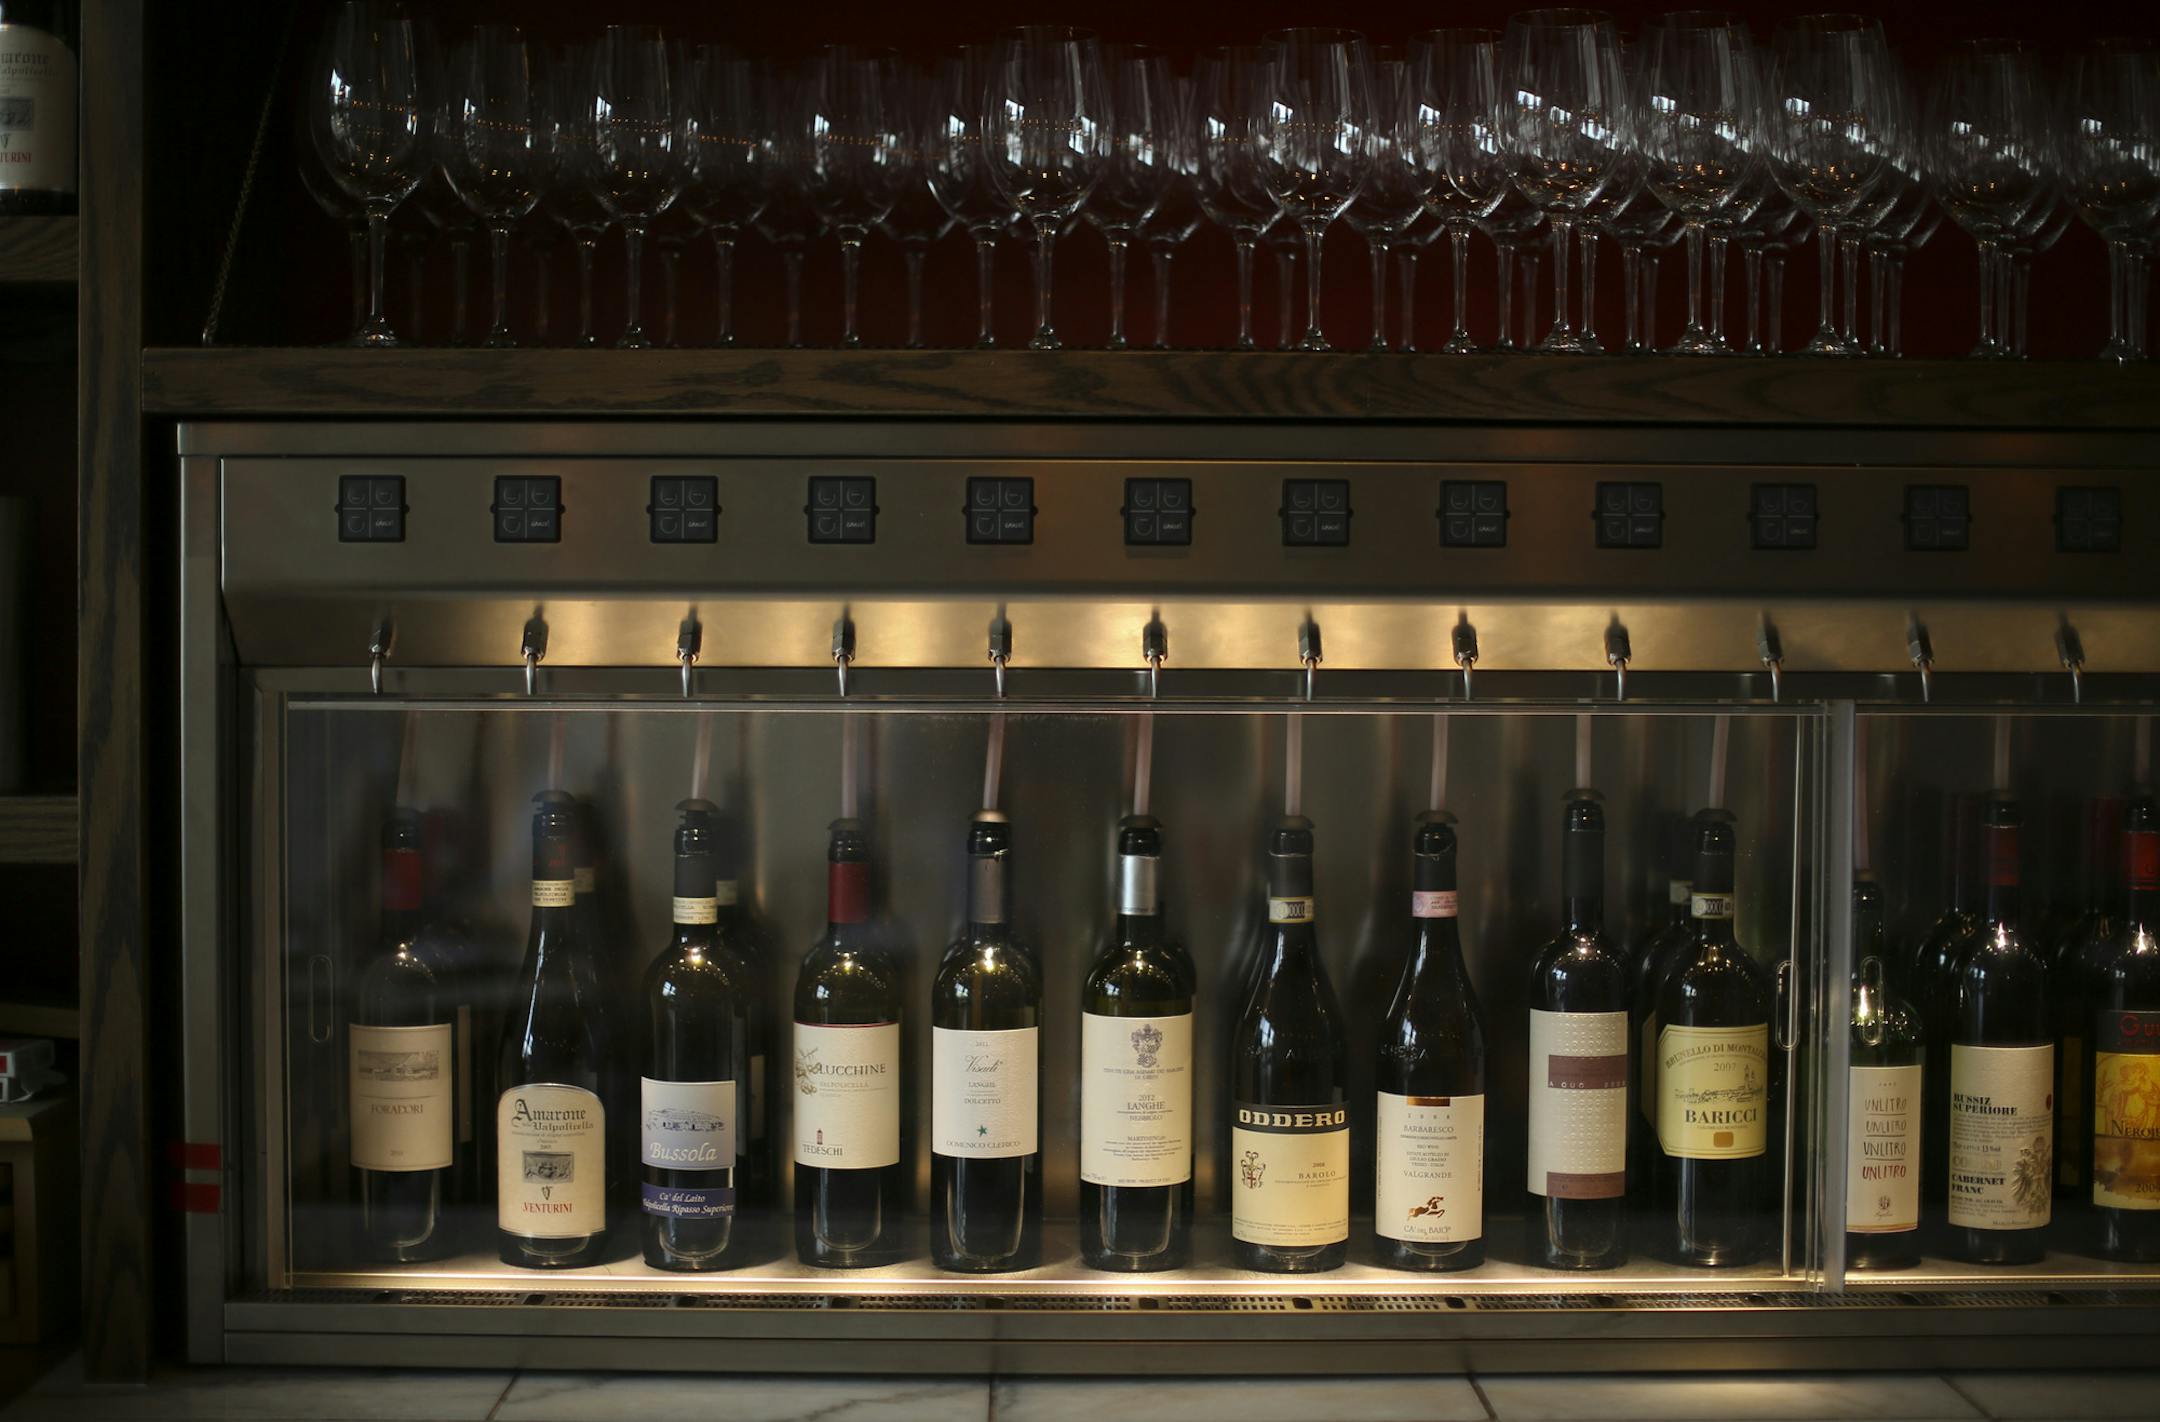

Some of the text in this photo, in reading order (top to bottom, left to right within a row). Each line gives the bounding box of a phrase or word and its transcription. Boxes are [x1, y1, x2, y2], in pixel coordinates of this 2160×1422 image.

[1665, 1044, 1711, 1069] BRUNELLO
[1713, 1043, 1724, 1053] DI
[819, 1063, 887, 1076] LUCCHINE
[1713, 1062, 1736, 1072] 2007
[1954, 1093, 1990, 1105] RUSSIZ
[371, 1103, 424, 1114] FORADORI
[512, 1098, 586, 1122] Amarone
[1128, 1102, 1166, 1110] LANGHE
[1953, 1102, 2018, 1115] SUPERIORE
[1239, 1109, 1346, 1127] ODDERO
[1686, 1108, 1758, 1124] BARICCI
[532, 1121, 594, 1132] Valpolicella
[1404, 1125, 1455, 1133] BARBARESCO
[803, 1144, 843, 1156] TEDESCHI
[947, 1140, 1021, 1149] DOMENICO CLERICO
[650, 1143, 717, 1161] Bussola
[1299, 1171, 1336, 1179] BAROLO
[1862, 1165, 1906, 1181] UNLITRO
[1952, 1175, 2005, 1185] CABERNET
[1952, 1184, 1984, 1194] FRANC
[523, 1202, 573, 1213] VENTURINI
